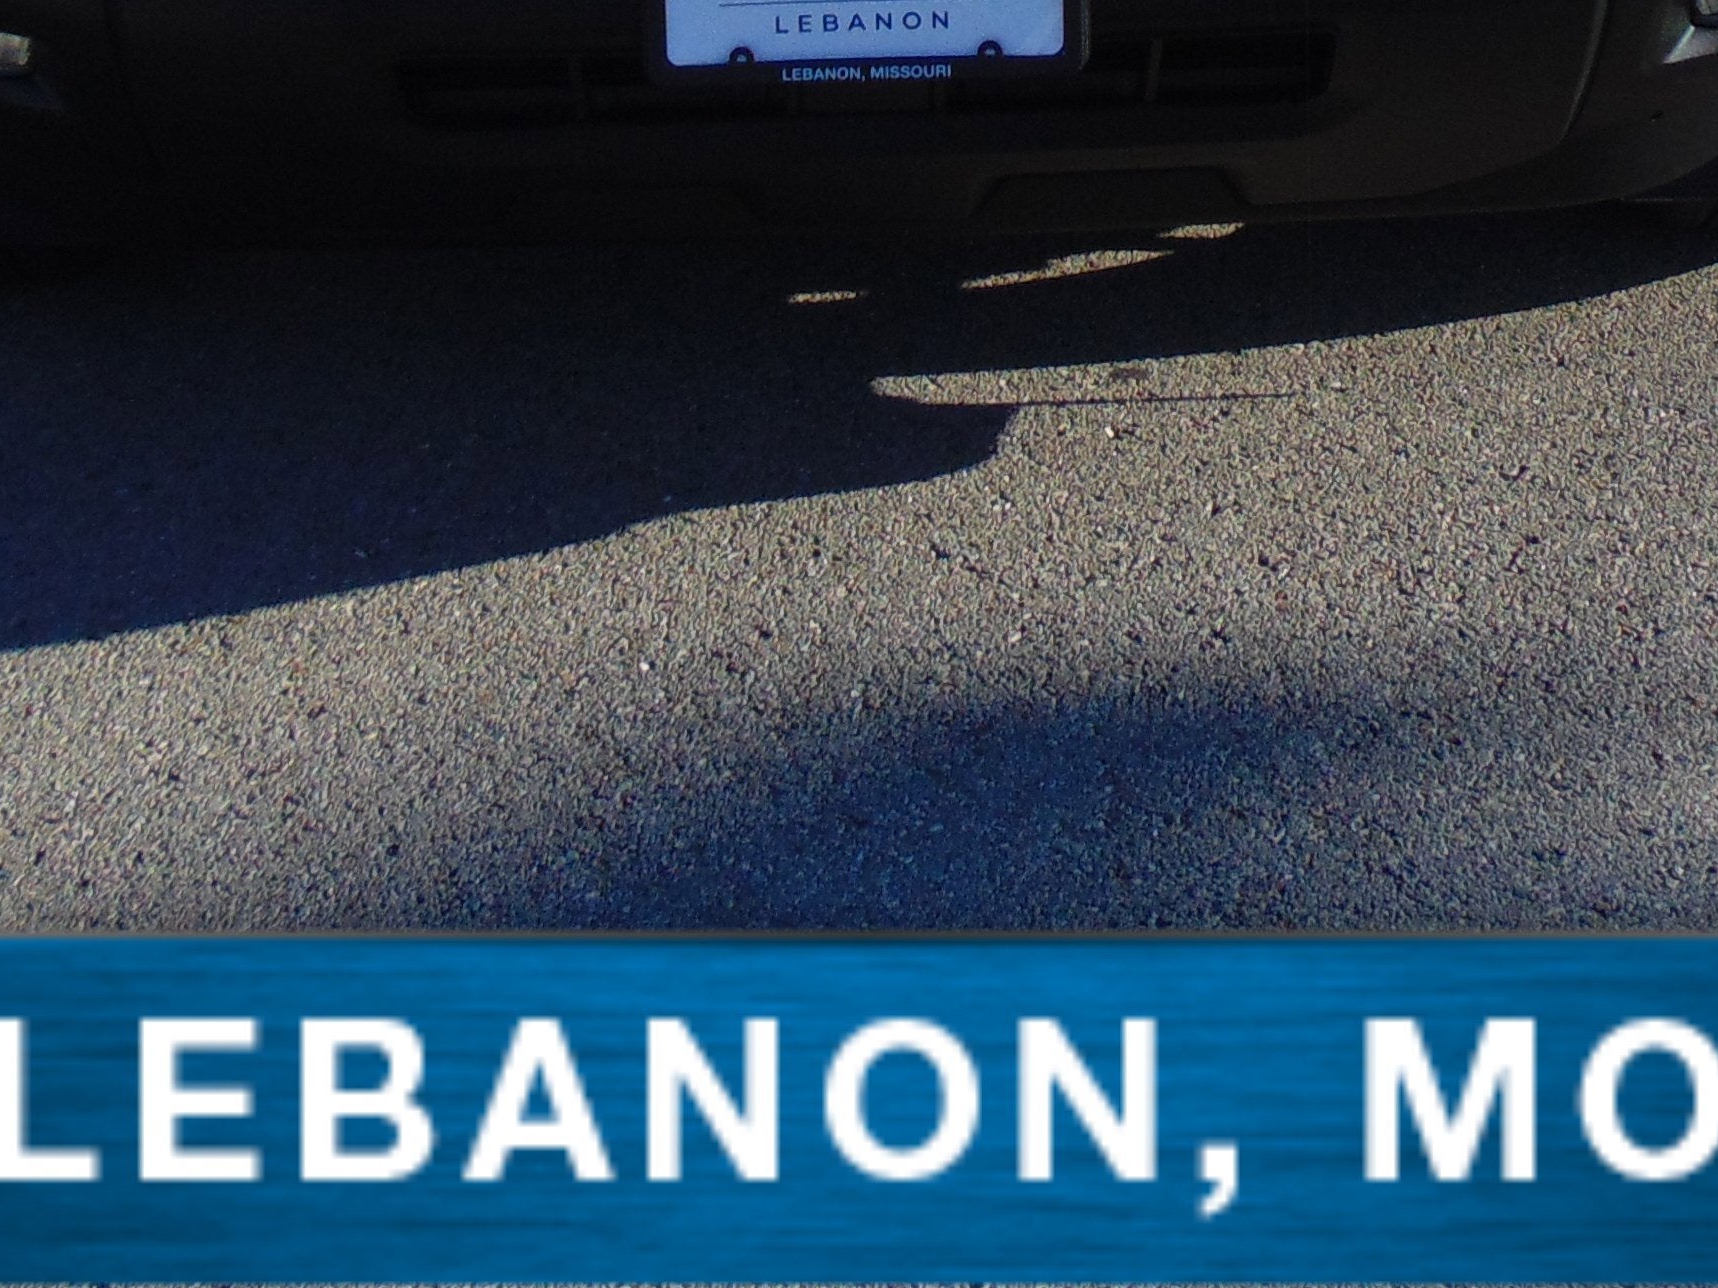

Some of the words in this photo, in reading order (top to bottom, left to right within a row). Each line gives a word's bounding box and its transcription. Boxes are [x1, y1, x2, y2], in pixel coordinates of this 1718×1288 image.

[775, 10, 950, 34] LEBANON
[782, 66, 867, 83] LEBANON,
[870, 63, 952, 81] MISSOURI
